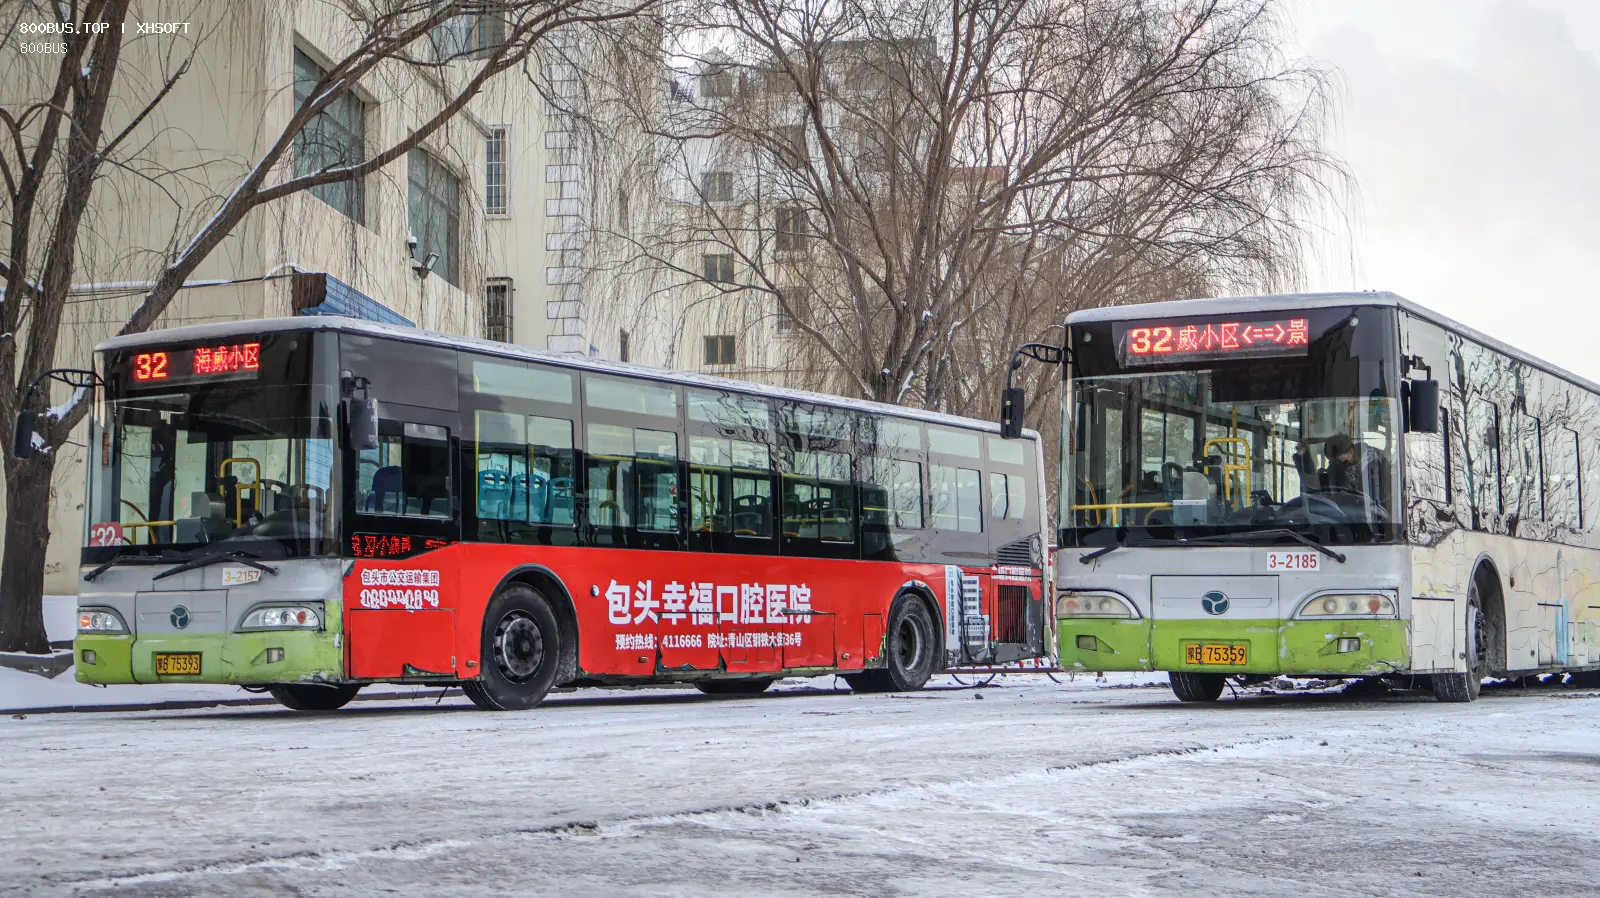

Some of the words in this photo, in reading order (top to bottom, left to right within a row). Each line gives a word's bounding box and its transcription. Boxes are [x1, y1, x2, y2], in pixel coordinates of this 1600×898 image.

[1131, 327, 1172, 354] 32
[135, 352, 168, 379] 32
[195, 343, 261, 374] 海威小区
[1269, 554, 1317, 570] 3-2185
[224, 570, 259, 583] 3-2157
[361, 568, 439, 586] 包头市公交运输集团
[604, 578, 812, 626] 包头幸福口腔医院
[662, 634, 702, 648] 4116666
